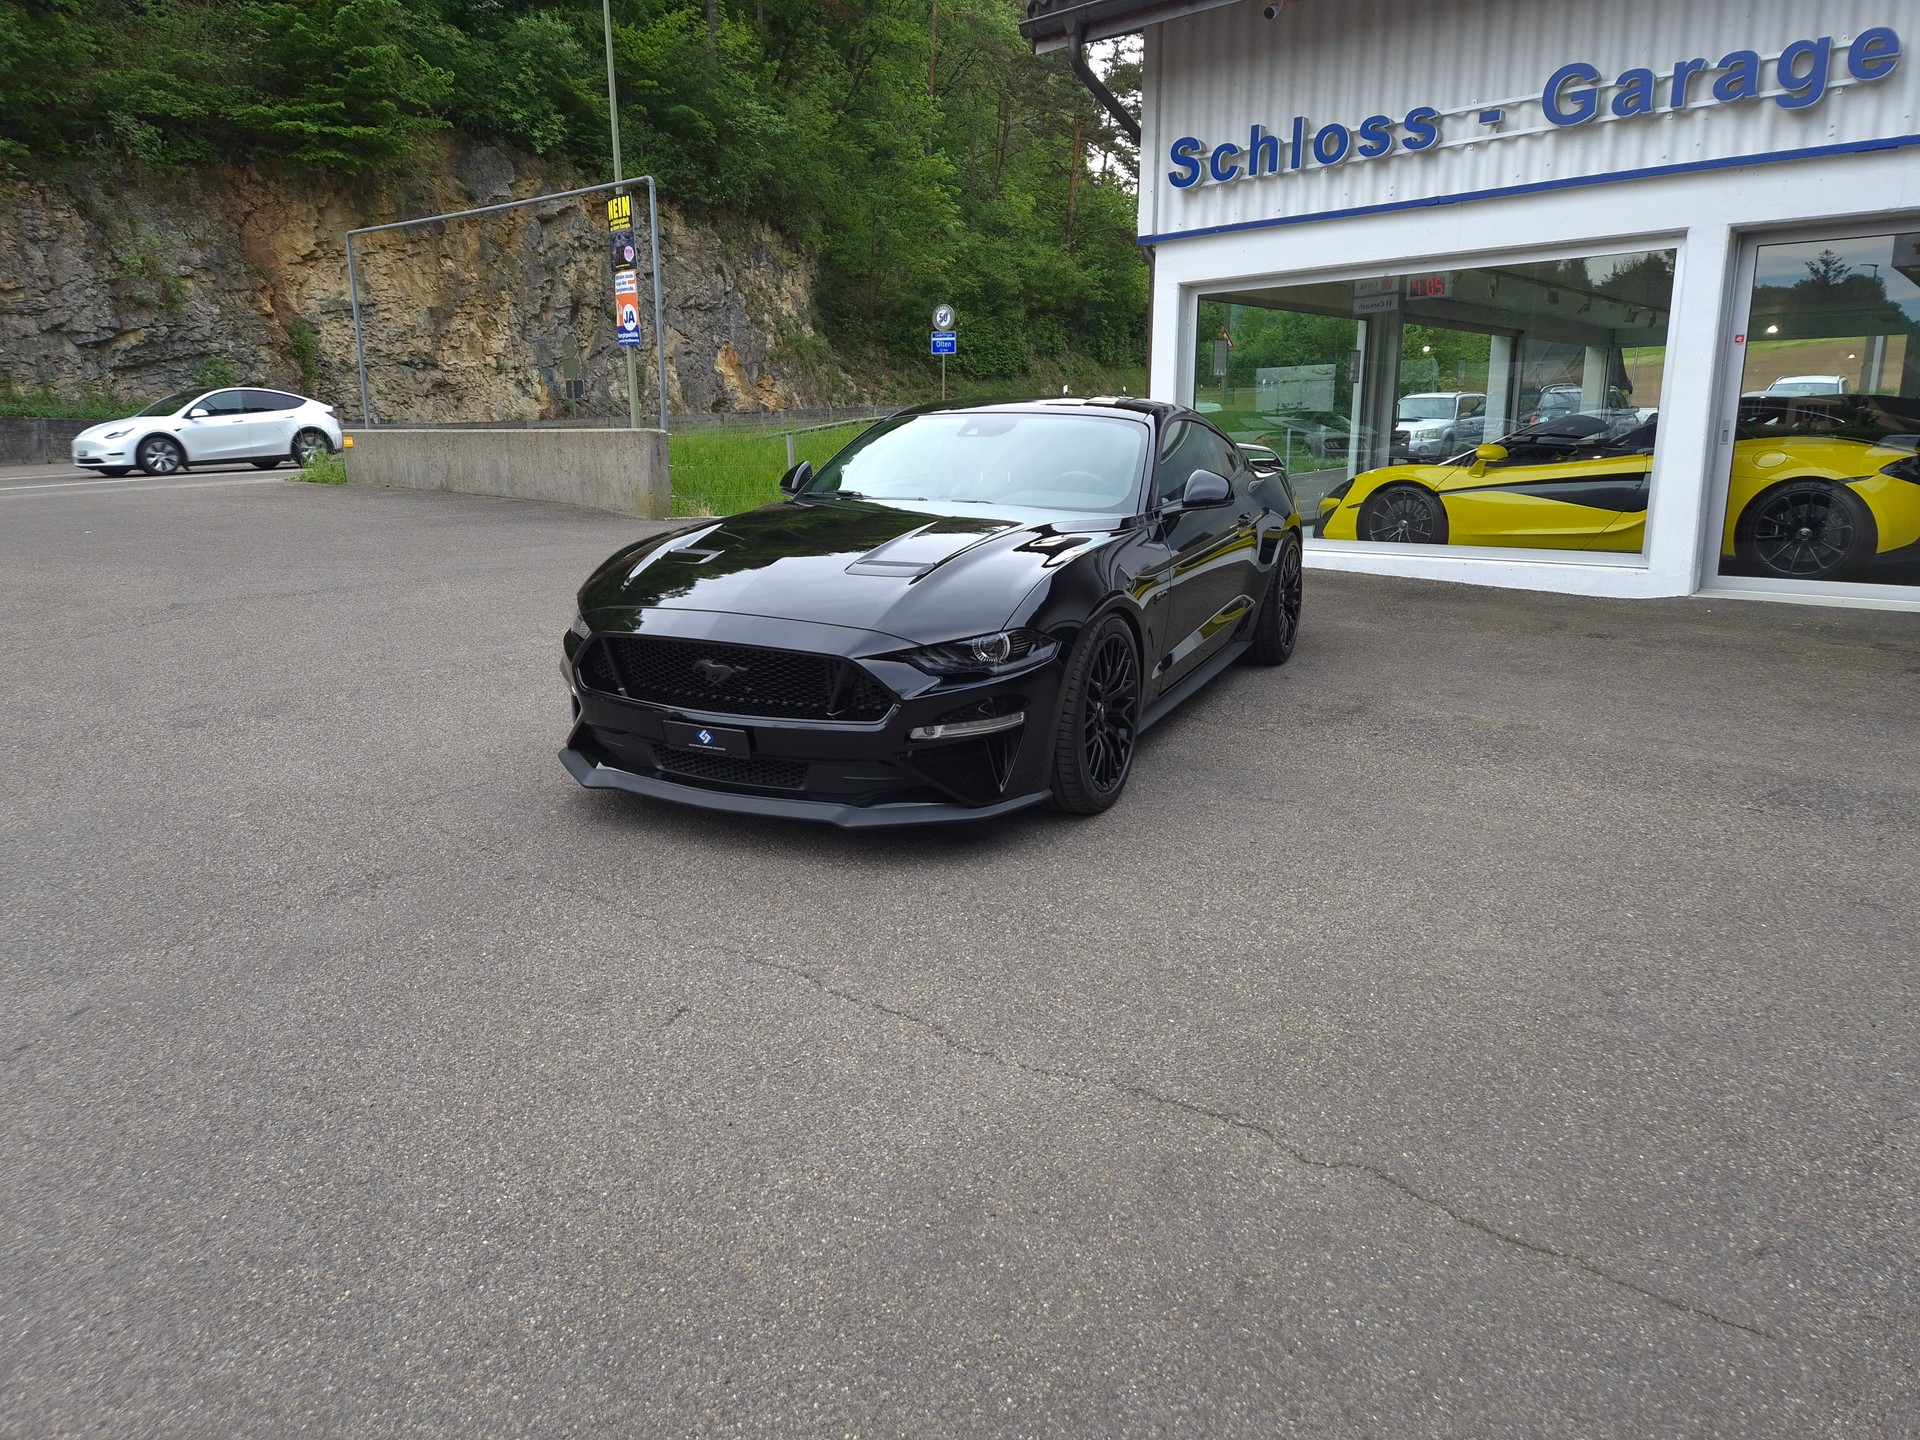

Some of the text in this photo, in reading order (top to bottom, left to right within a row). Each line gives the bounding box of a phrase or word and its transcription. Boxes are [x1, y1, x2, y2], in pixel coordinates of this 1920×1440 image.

[1168, 106, 1441, 189] Schloss
[1541, 26, 1903, 129] Garage
[607, 195, 631, 221] NEIN
[623, 311, 636, 324] JA
[939, 312, 948, 323] 50
[935, 340, 952, 348] Olten
